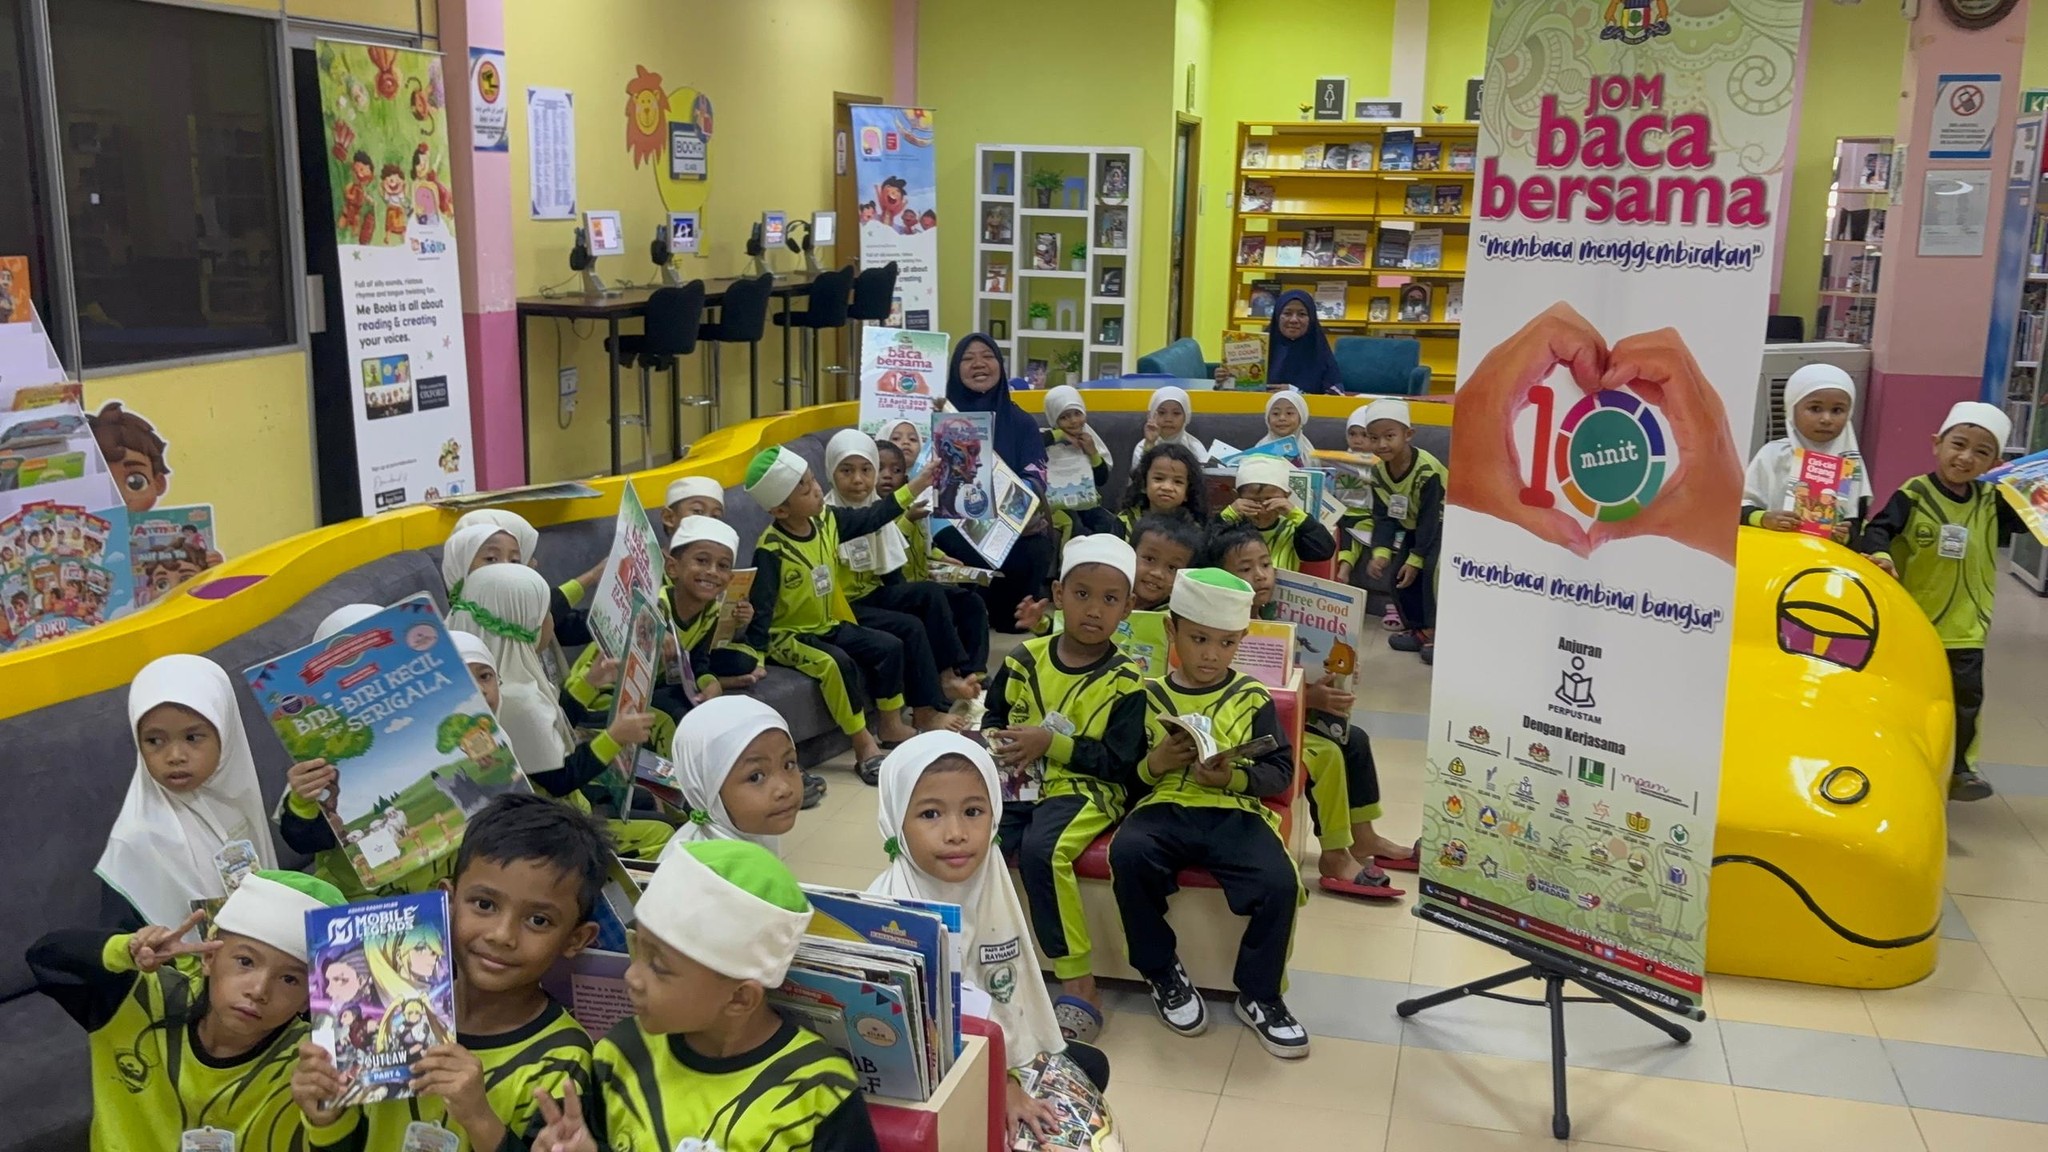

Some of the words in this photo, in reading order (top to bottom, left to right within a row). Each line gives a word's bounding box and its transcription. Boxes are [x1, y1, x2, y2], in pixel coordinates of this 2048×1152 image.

[1584, 73, 1664, 117] JOM
[1536, 94, 1715, 170] baca
[1479, 157, 1770, 228] bersama
[356, 304, 371, 315] Me
[373, 302, 397, 314] Books
[399, 301, 406, 311] is
[408, 300, 419, 311] all
[420, 299, 444, 309] about
[358, 317, 393, 331] reading
[394, 316, 401, 327] &
[402, 314, 437, 327] creating
[359, 335, 381, 349] your
[383, 332, 411, 344] voices.
[876, 355, 933, 369] bersama
[888, 346, 922, 359] baca
[1579, 440, 1639, 470] minit
[1276, 587, 1313, 607] Three
[1316, 597, 1349, 617] Good
[1550, 578, 1635, 611] membina
[35, 619, 67, 639] BUKU
[1276, 600, 1347, 636] Friends
[1557, 636, 1602, 659] Anjuran
[292, 678, 387, 736] BIRI-BIRI
[384, 652, 444, 689] KECIL
[346, 671, 453, 732] SERIGALA
[1548, 703, 1602, 725] PERPUSTAM
[1523, 714, 1563, 740] Dengan
[1564, 726, 1626, 756] Kerjasama
[1537, 878, 1570, 894] MALAYSIA
[1537, 884, 1570, 901] MADANI
[355, 904, 419, 926] MOBILE
[355, 919, 414, 940] LEGENDS
[1565, 926, 1589, 939] IKUTI
[1590, 932, 1616, 948] KAMI
[1629, 944, 1659, 963] MEDIA
[1660, 958, 1695, 977] SOSIAL
[364, 1050, 407, 1069] OUTLAW
[373, 1070, 394, 1081] PART
